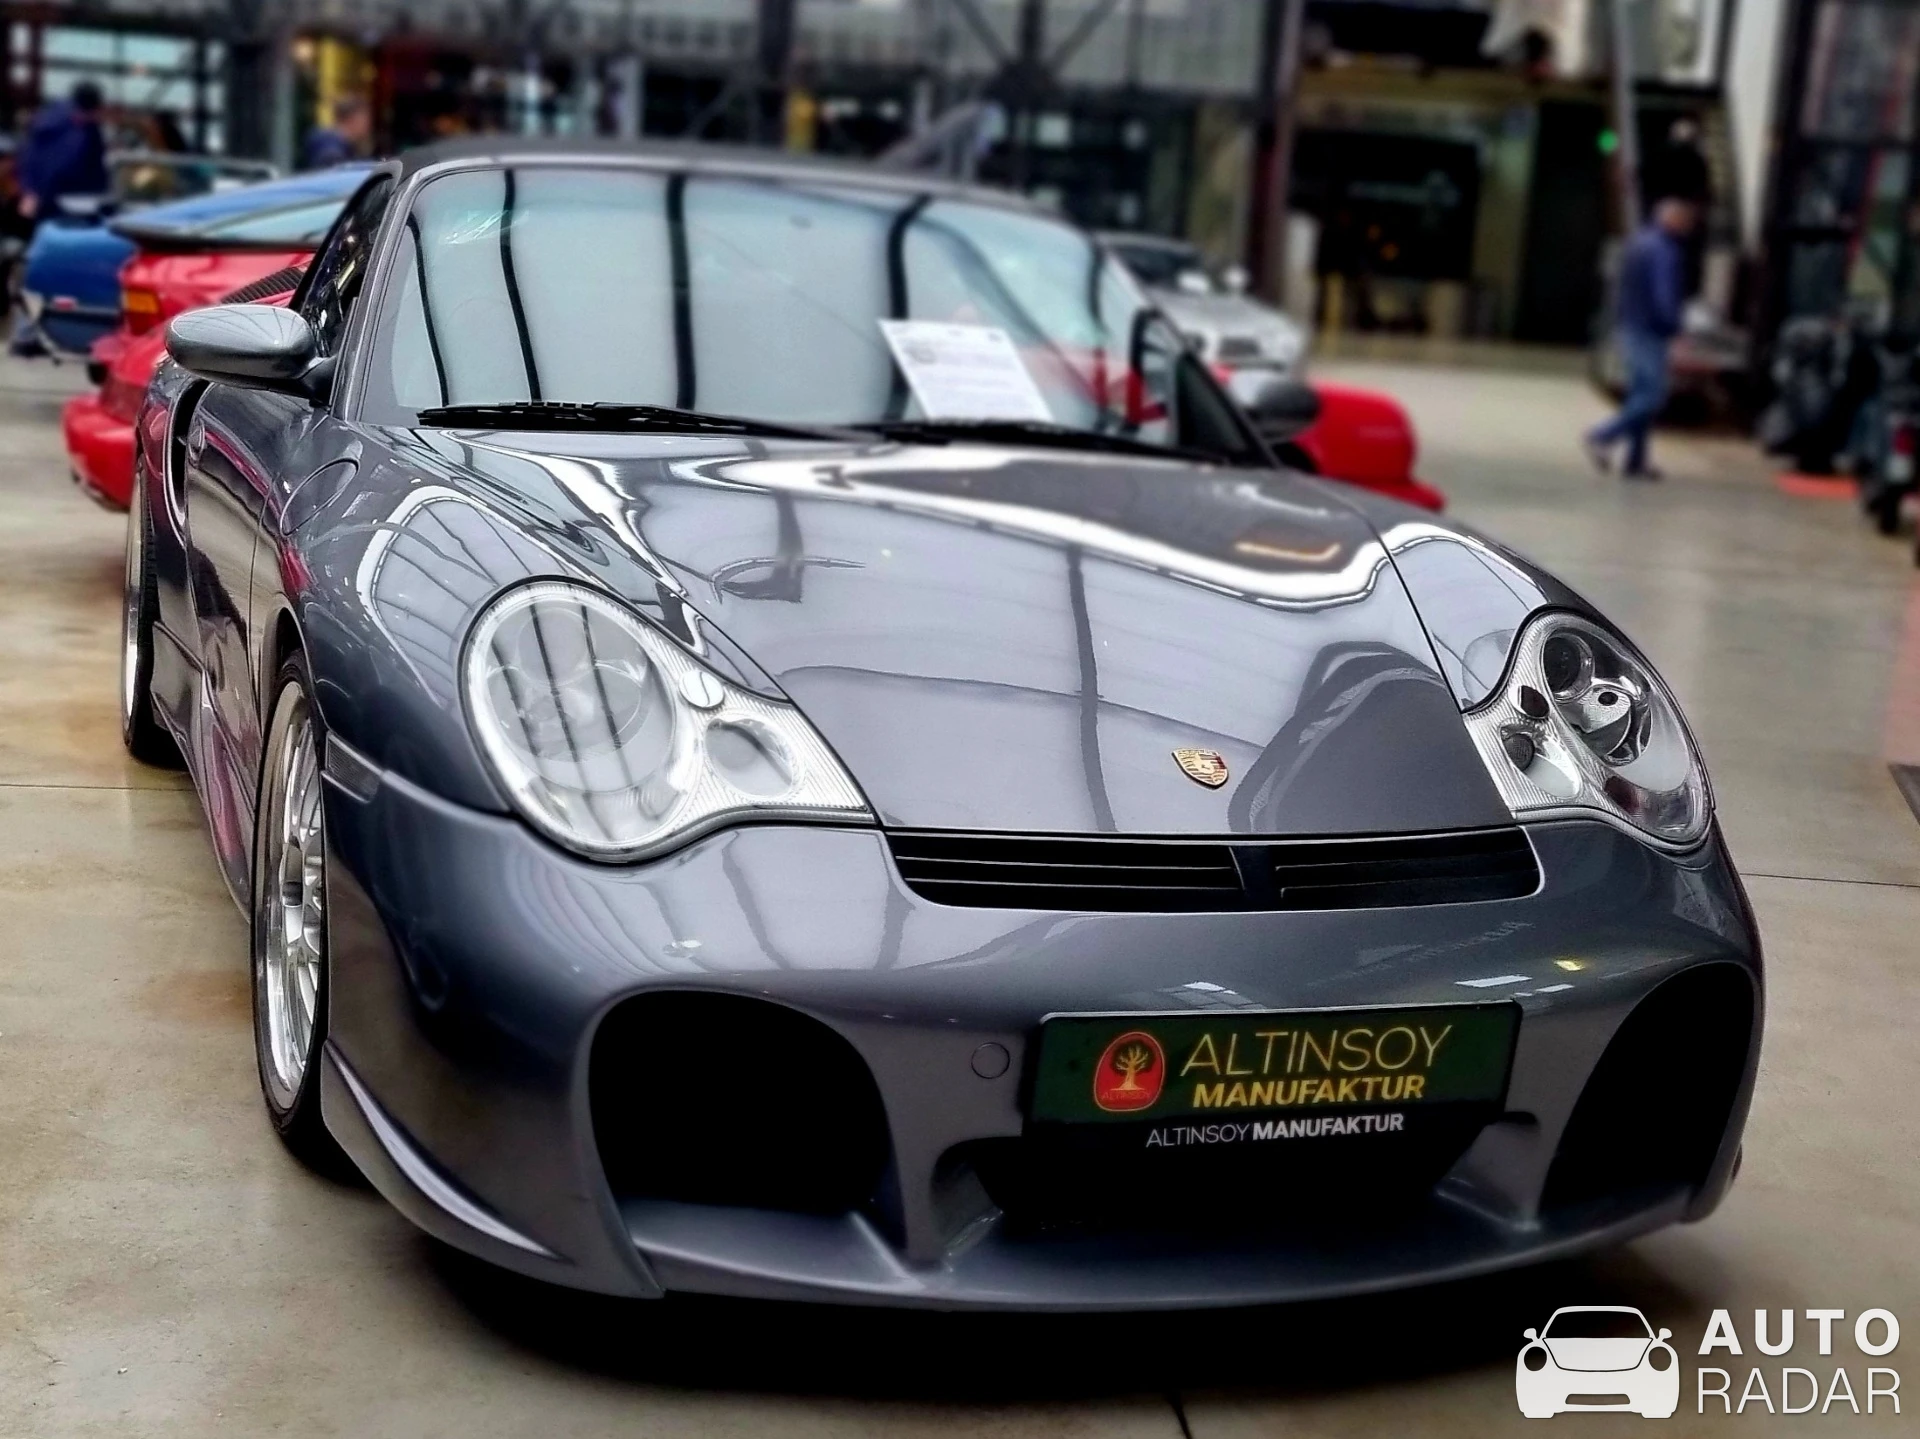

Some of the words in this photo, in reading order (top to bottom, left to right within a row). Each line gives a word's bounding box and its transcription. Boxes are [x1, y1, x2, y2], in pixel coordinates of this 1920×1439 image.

[1180, 1025, 1453, 1077] ALTINSOY
[1193, 1075, 1425, 1108] MANUFAKTUR
[1146, 1124, 1250, 1148] ALTINSOY
[1252, 1113, 1404, 1140] MANUFAKTUR
